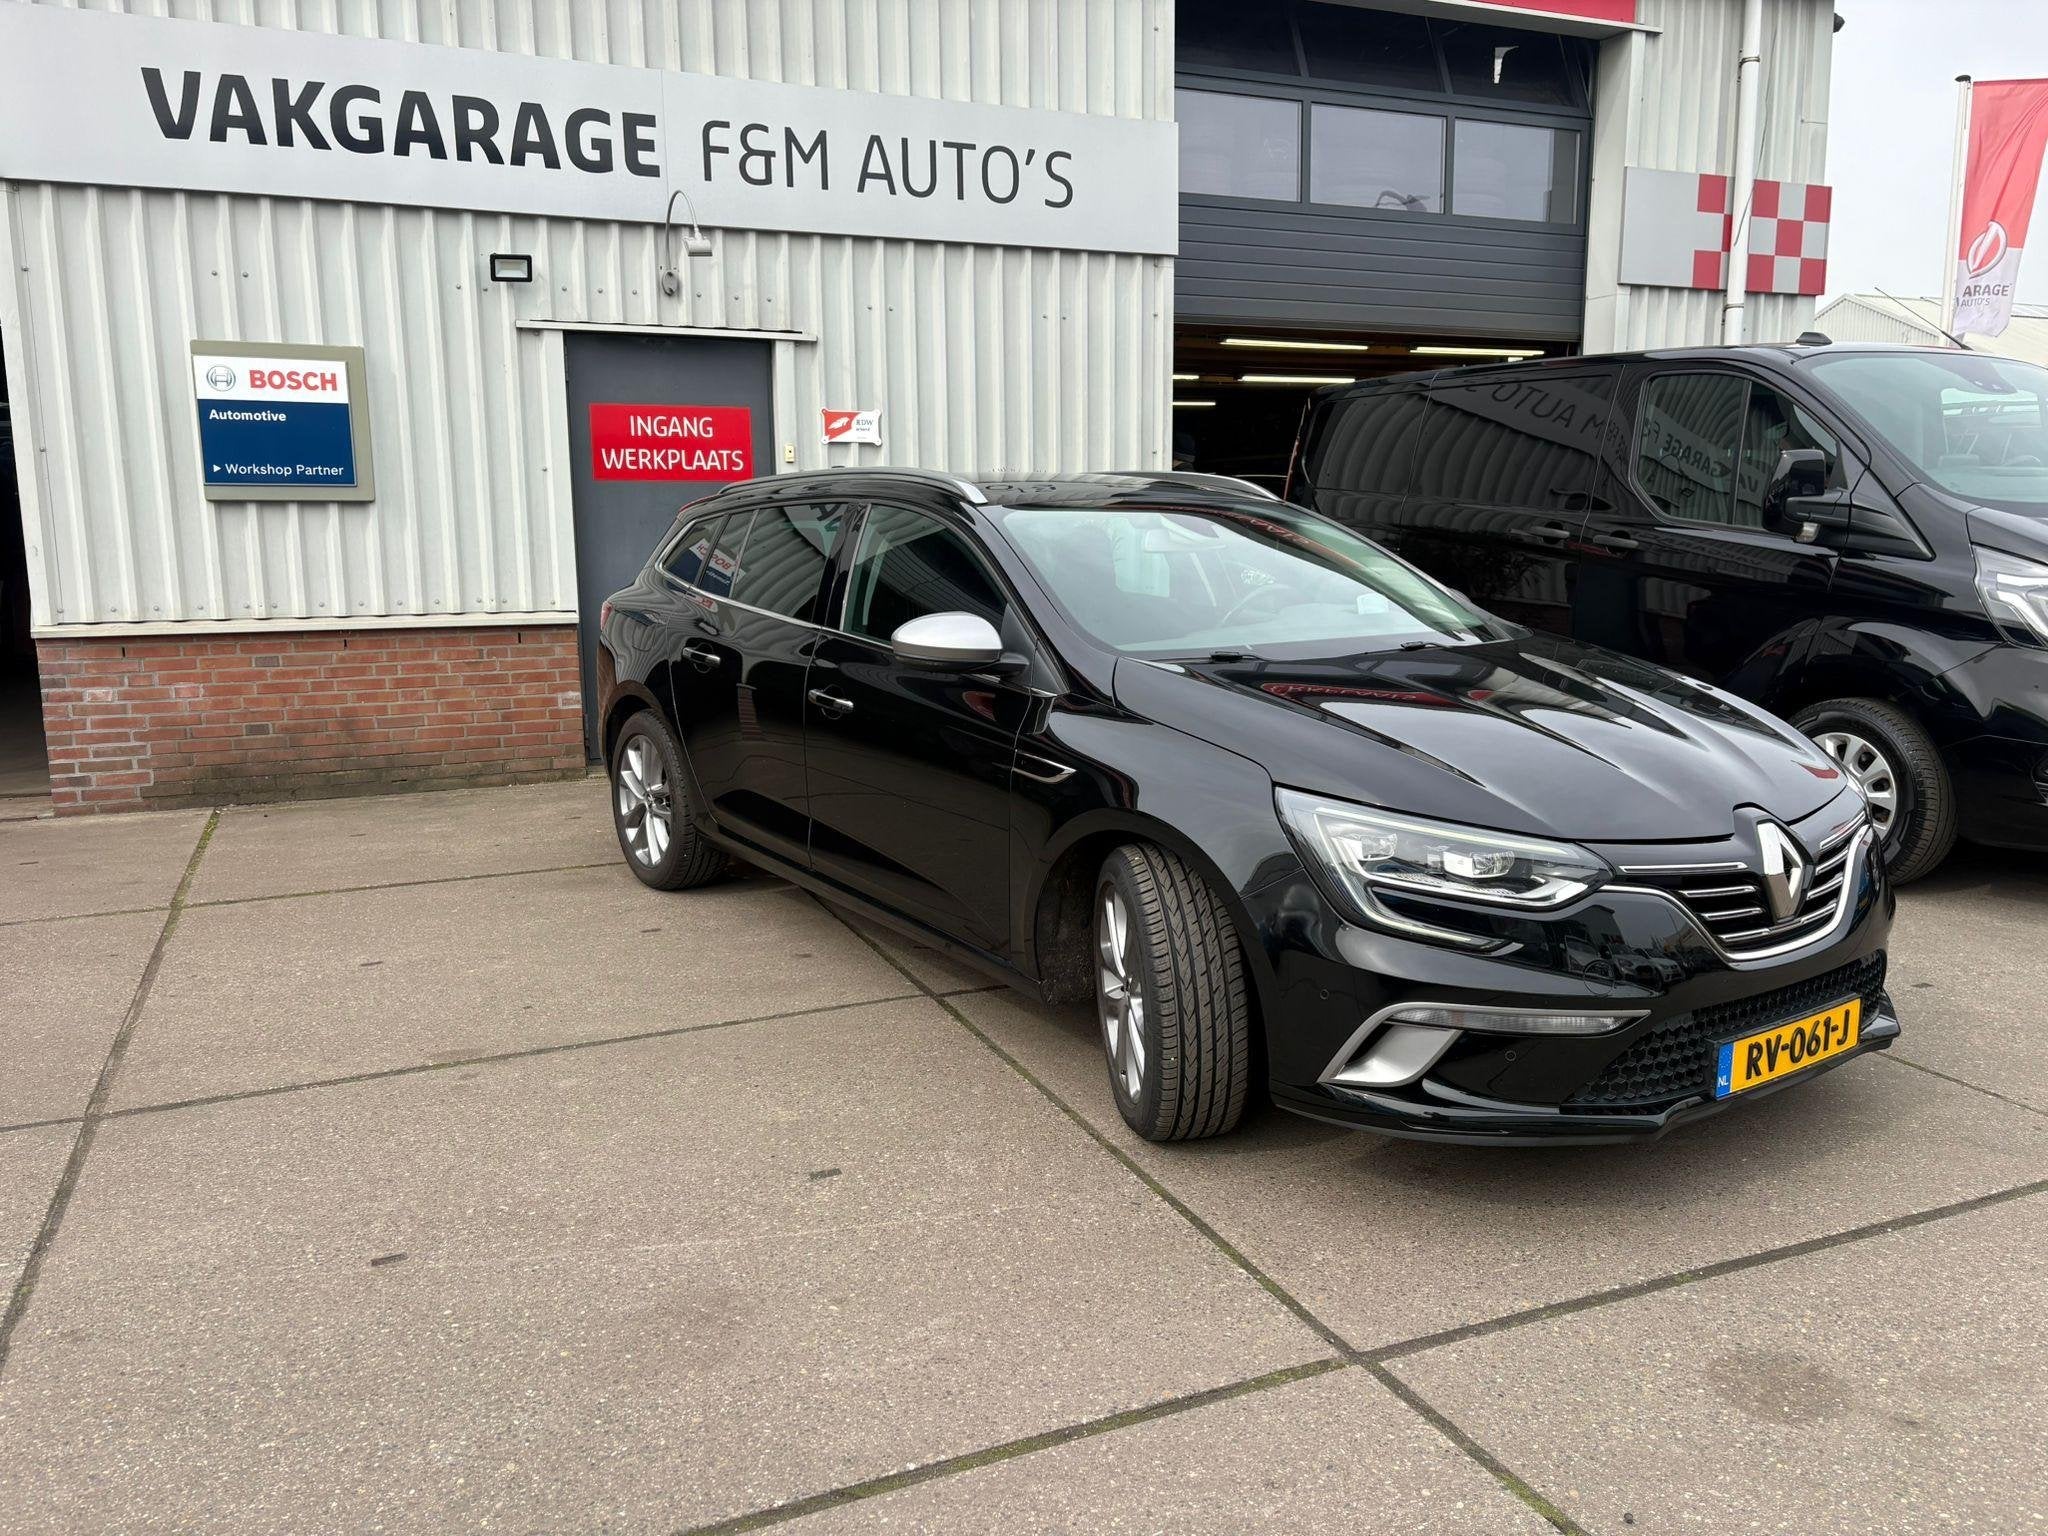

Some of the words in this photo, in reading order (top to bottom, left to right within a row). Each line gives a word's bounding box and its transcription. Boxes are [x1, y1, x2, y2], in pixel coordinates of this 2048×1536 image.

[141, 67, 661, 178] VAKGARAGE
[702, 120, 829, 191] F&M
[857, 134, 1073, 208] AUTO'S
[1963, 283, 2009, 298] ARAGE
[249, 369, 337, 392] BOSCH
[209, 408, 287, 422] Automotive
[629, 415, 713, 438] INGANG
[225, 463, 293, 478] Workshop
[296, 464, 344, 476] Partner
[601, 448, 744, 471] WERKPLAATS
[1746, 1008, 1850, 1080] RV-061-J
[1717, 1075, 1729, 1088] NL
